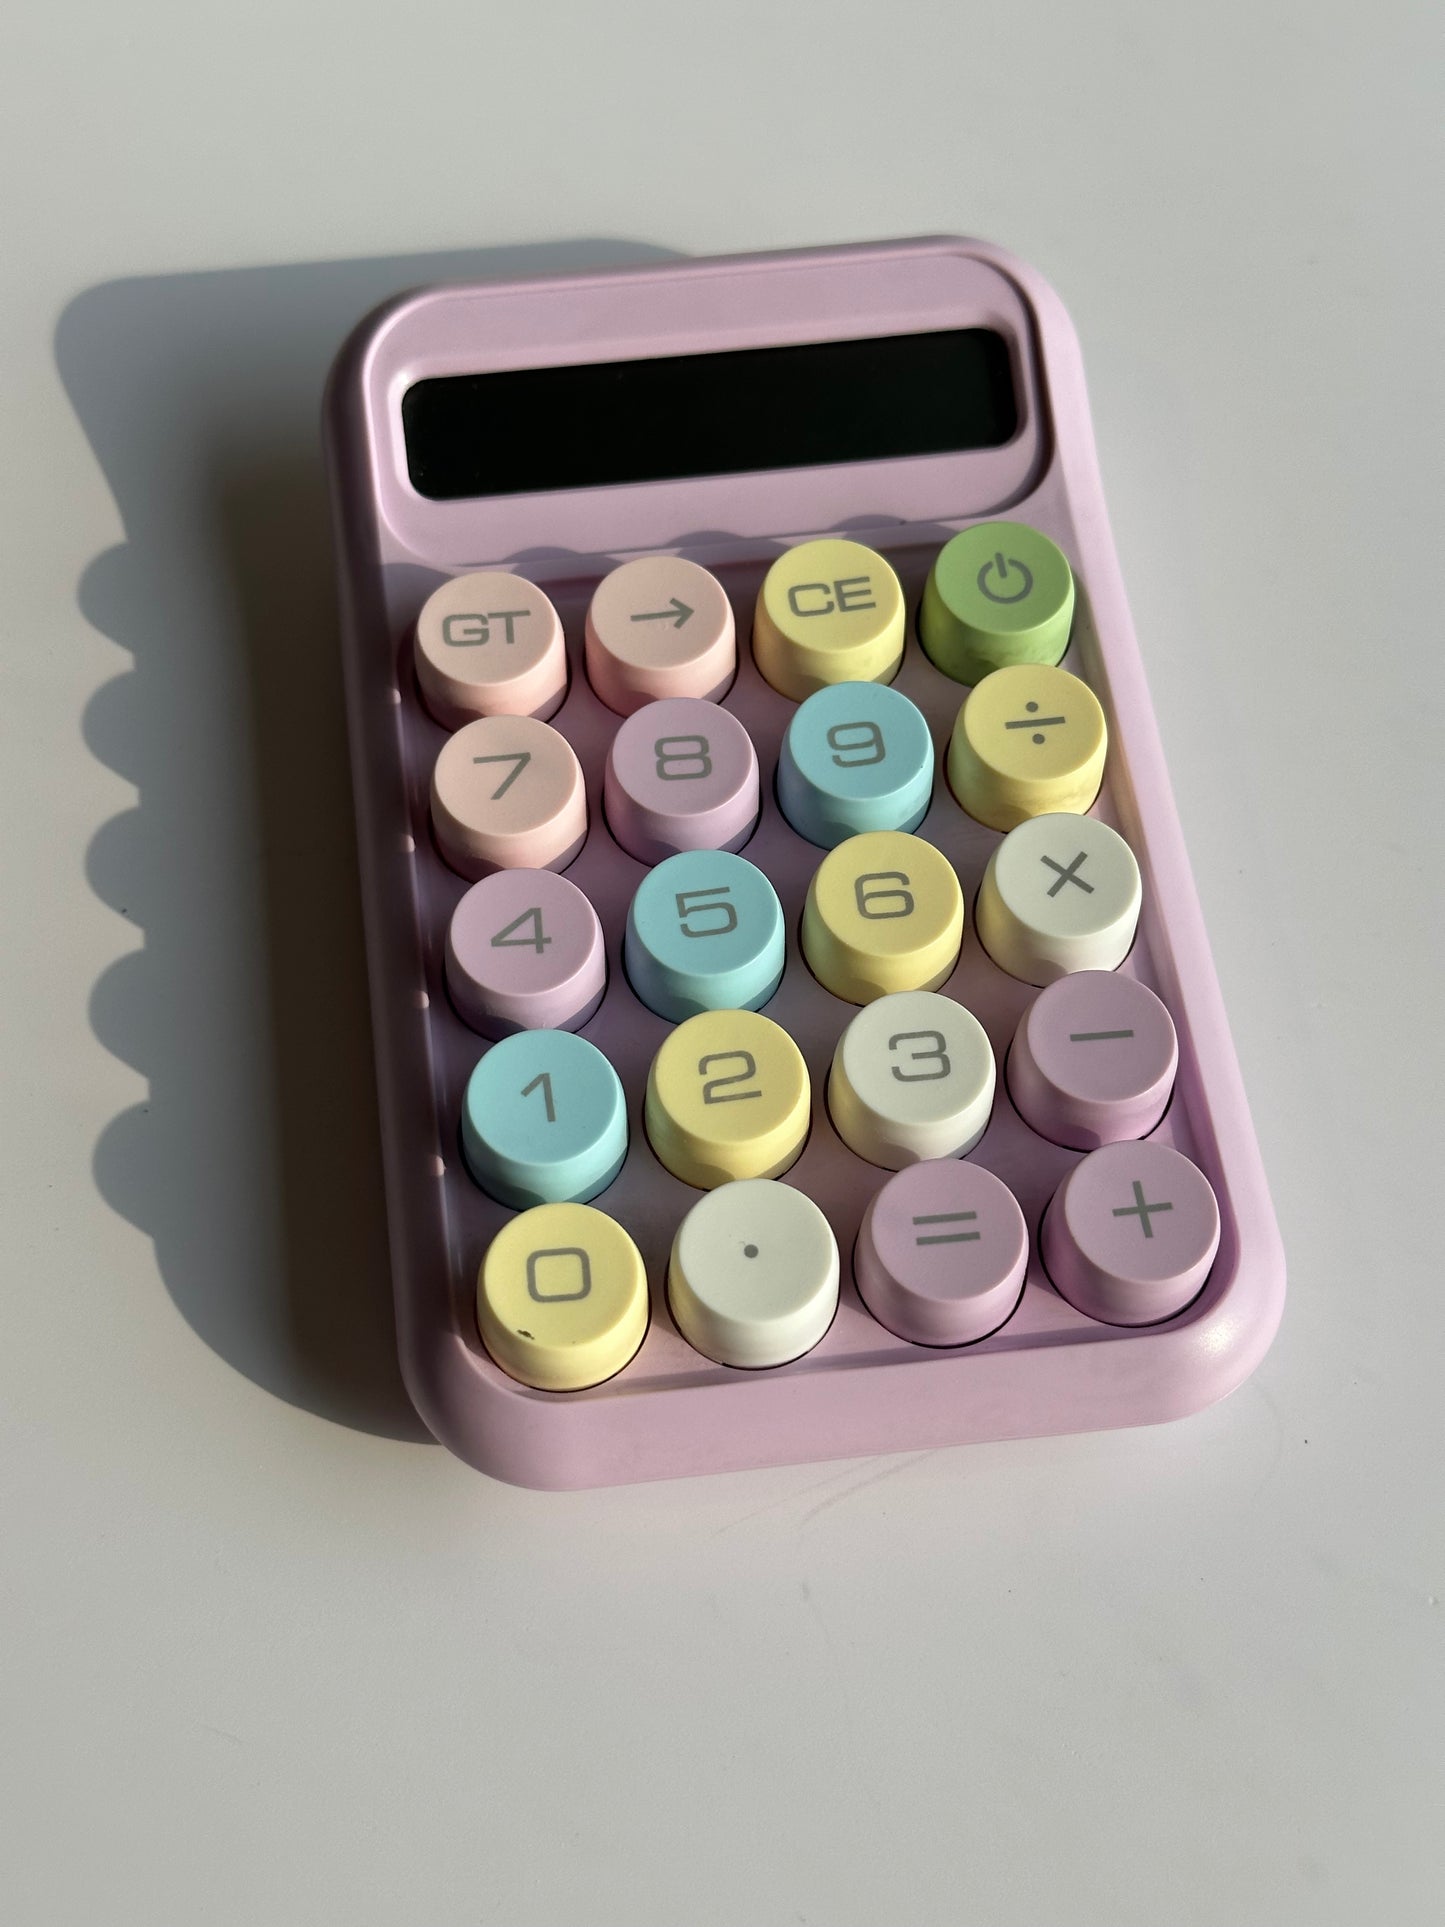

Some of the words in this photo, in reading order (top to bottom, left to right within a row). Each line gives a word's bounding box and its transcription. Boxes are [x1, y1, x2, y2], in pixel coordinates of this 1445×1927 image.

[788, 576, 876, 617] CE
[443, 610, 531, 647] GT
[655, 735, 712, 780] 8
[827, 722, 886, 767] 9
[474, 752, 531, 800] 7
[676, 887, 737, 937] 5
[855, 872, 914, 919] 6
[490, 908, 552, 954] 4
[699, 1051, 762, 1104] 2
[889, 1031, 951, 1082] 3
[521, 1073, 556, 1122] 1
